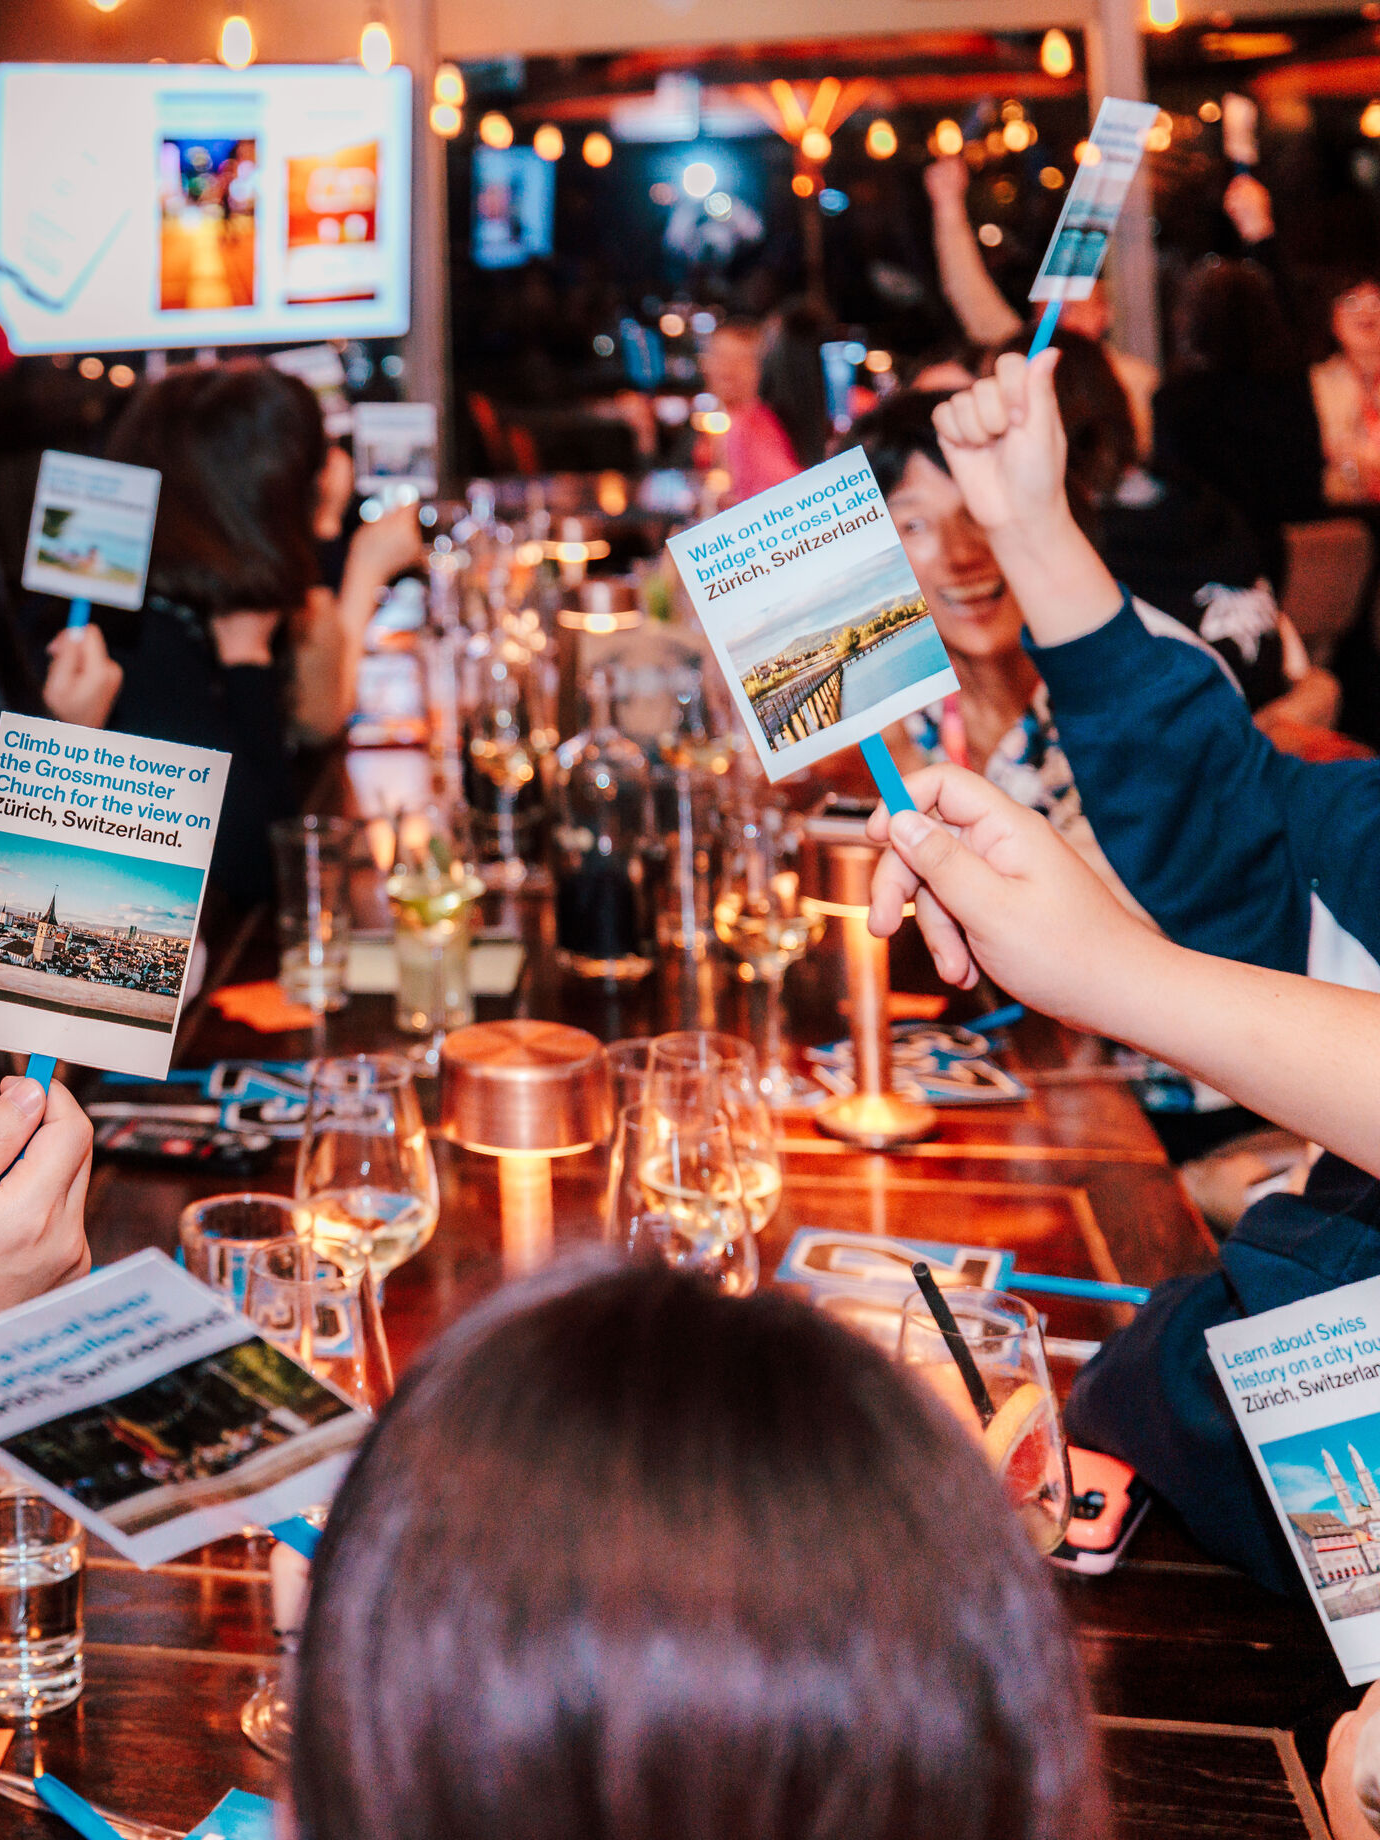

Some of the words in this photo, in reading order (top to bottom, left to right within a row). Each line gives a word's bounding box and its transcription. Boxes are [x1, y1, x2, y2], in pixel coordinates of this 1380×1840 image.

[687, 533, 738, 563] Walk
[738, 521, 762, 540] on
[763, 505, 794, 527] the
[797, 468, 871, 511] wooden
[696, 546, 756, 583] bridge
[758, 536, 778, 552] to
[781, 510, 832, 541] cross
[832, 487, 879, 517] Lake
[704, 564, 771, 601] Zürich,
[771, 505, 884, 568] Switzerland.
[0, 752, 31, 773] the
[35, 759, 175, 800] Grossmunster
[4, 730, 61, 756] Climb
[64, 745, 89, 764] up
[93, 747, 125, 768] the
[129, 754, 186, 779] tower
[188, 767, 210, 784] of
[62, 810, 182, 848] Switzerland.
[70, 788, 98, 808] for
[102, 795, 133, 815] the
[138, 803, 182, 824] view
[185, 814, 211, 830] on
[1221, 1345, 1269, 1369] Learn
[1269, 1328, 1317, 1356] about
[1315, 1316, 1367, 1341] Swiss
[1231, 1365, 1287, 1392] history
[1288, 1359, 1311, 1375] on
[1311, 1355, 1323, 1369] a
[1323, 1345, 1354, 1364] city
[1242, 1387, 1301, 1414] Zürich,
